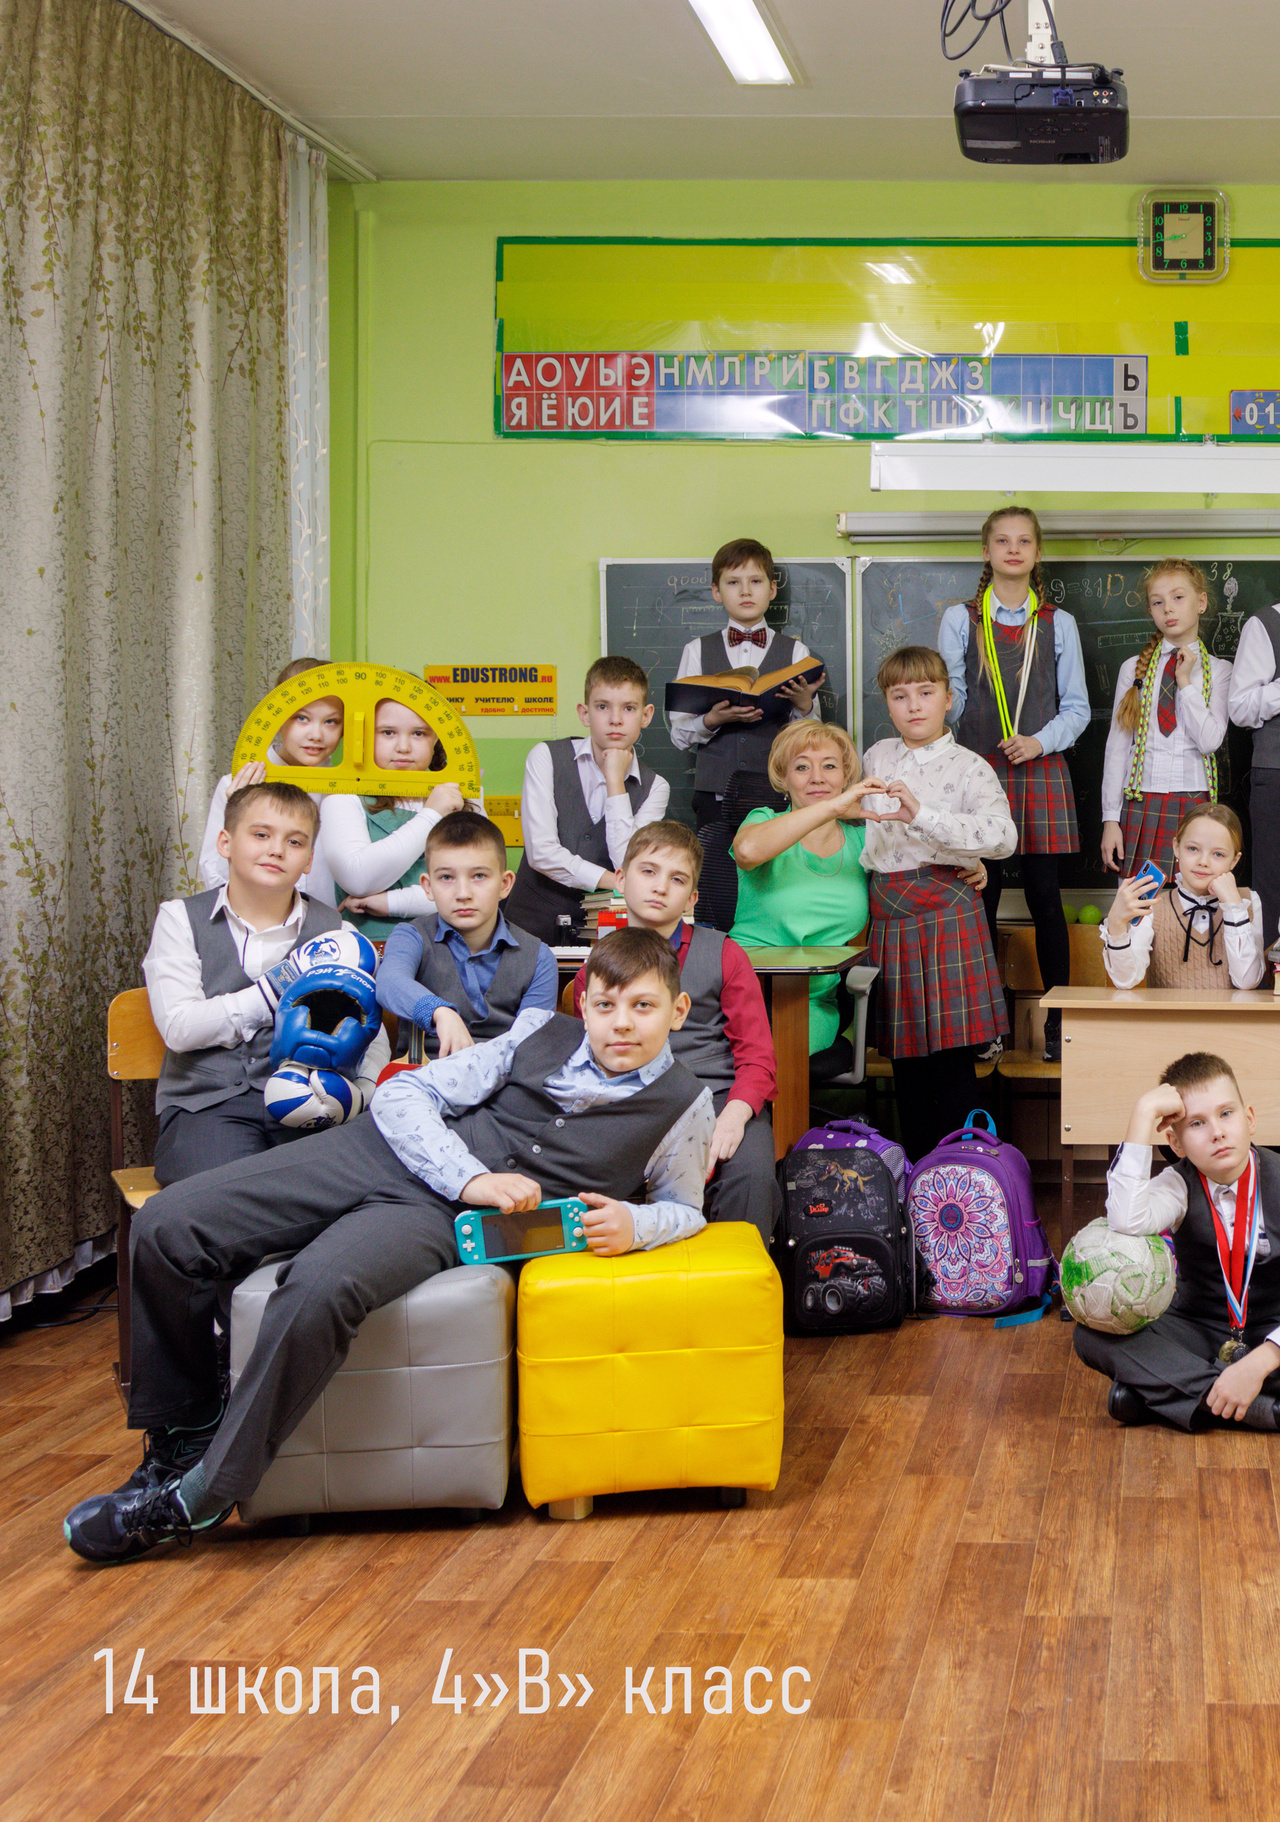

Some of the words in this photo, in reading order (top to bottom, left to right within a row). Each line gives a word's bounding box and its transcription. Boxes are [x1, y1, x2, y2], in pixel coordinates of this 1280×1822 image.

[1164, 204, 1170, 213] 11
[1180, 203, 1188, 213] 12
[1200, 204, 1203, 213] 1
[1155, 216, 1164, 225] 10
[1205, 216, 1212, 226] 2
[1206, 232, 1212, 241] 3
[1156, 247, 1162, 256] 8
[1205, 247, 1212, 256] 4
[1163, 260, 1170, 268] 7
[1180, 259, 1187, 268] 6
[1198, 259, 1204, 268] 5
[1245, 402, 1258, 425] 0
[1265, 402, 1275, 425] 1
[474, 696, 515, 704] УЧИТЕЛЮ
